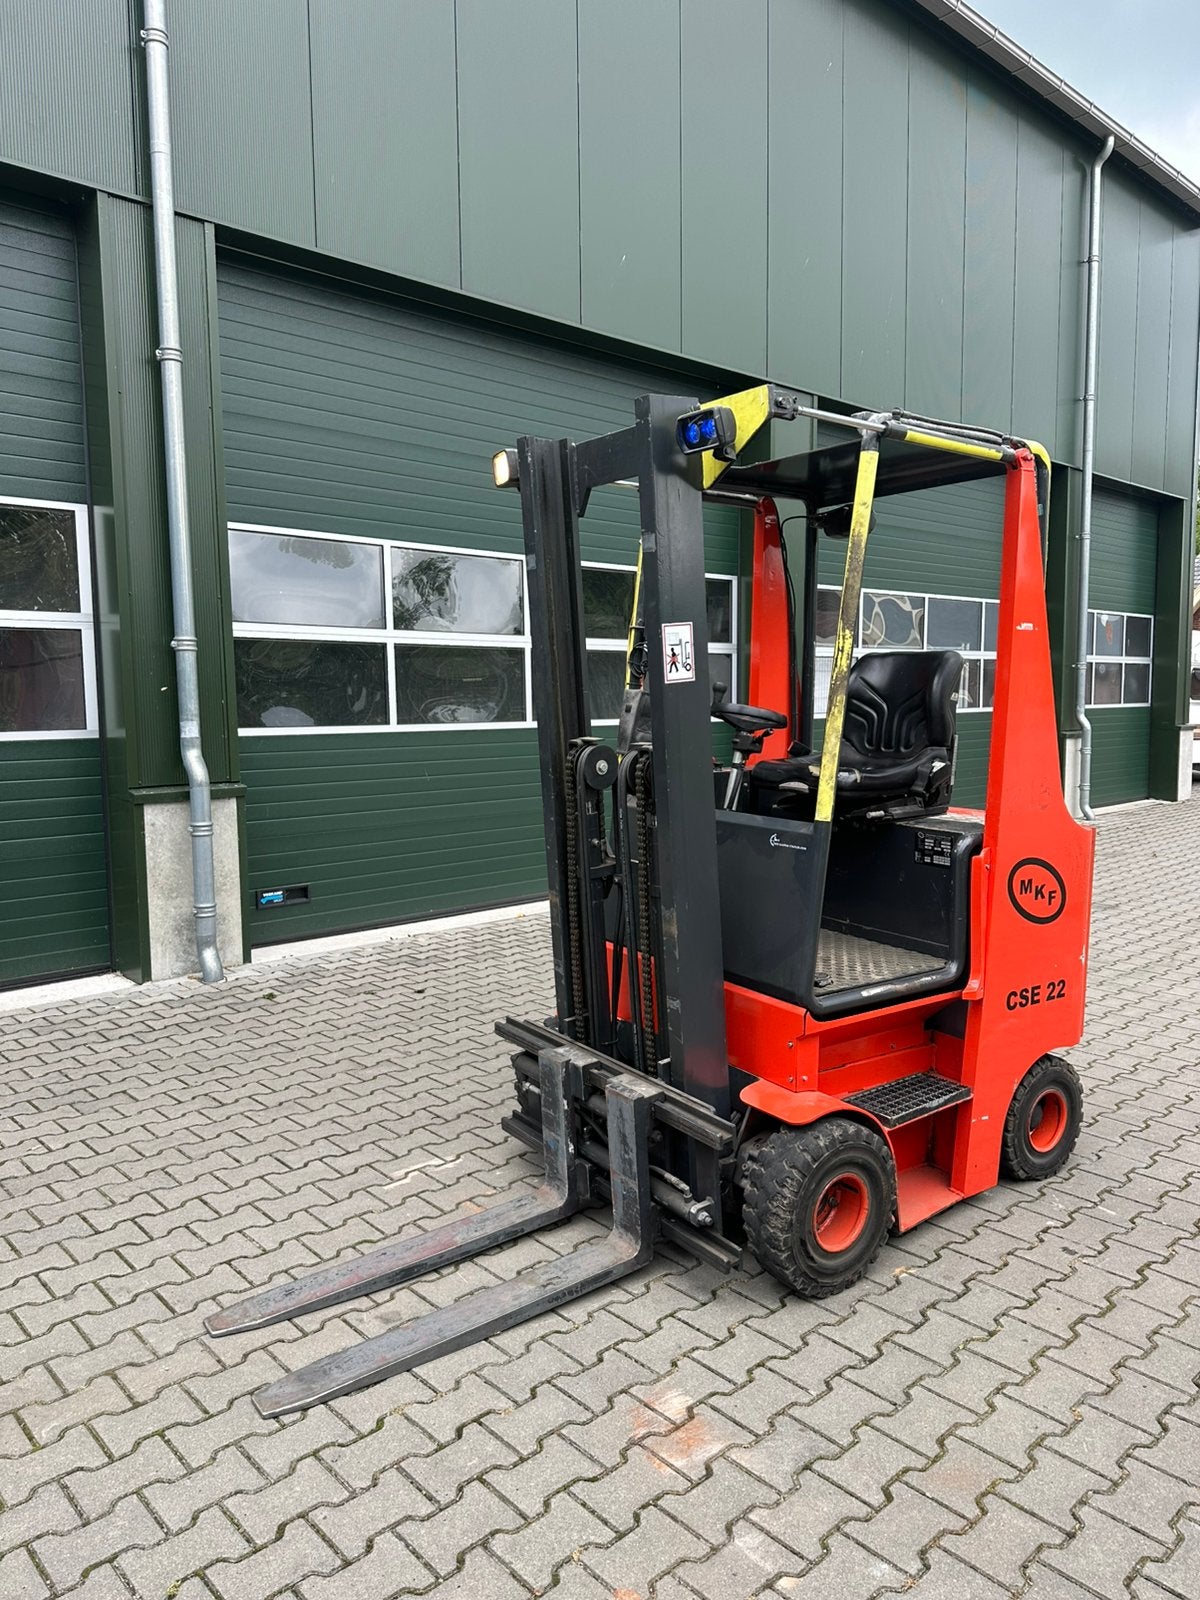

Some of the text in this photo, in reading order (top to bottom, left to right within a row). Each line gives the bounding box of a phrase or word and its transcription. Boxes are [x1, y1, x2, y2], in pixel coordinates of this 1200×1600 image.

[1019, 878, 1057, 906] MKF
[1006, 979, 1066, 1011] CSE 22
